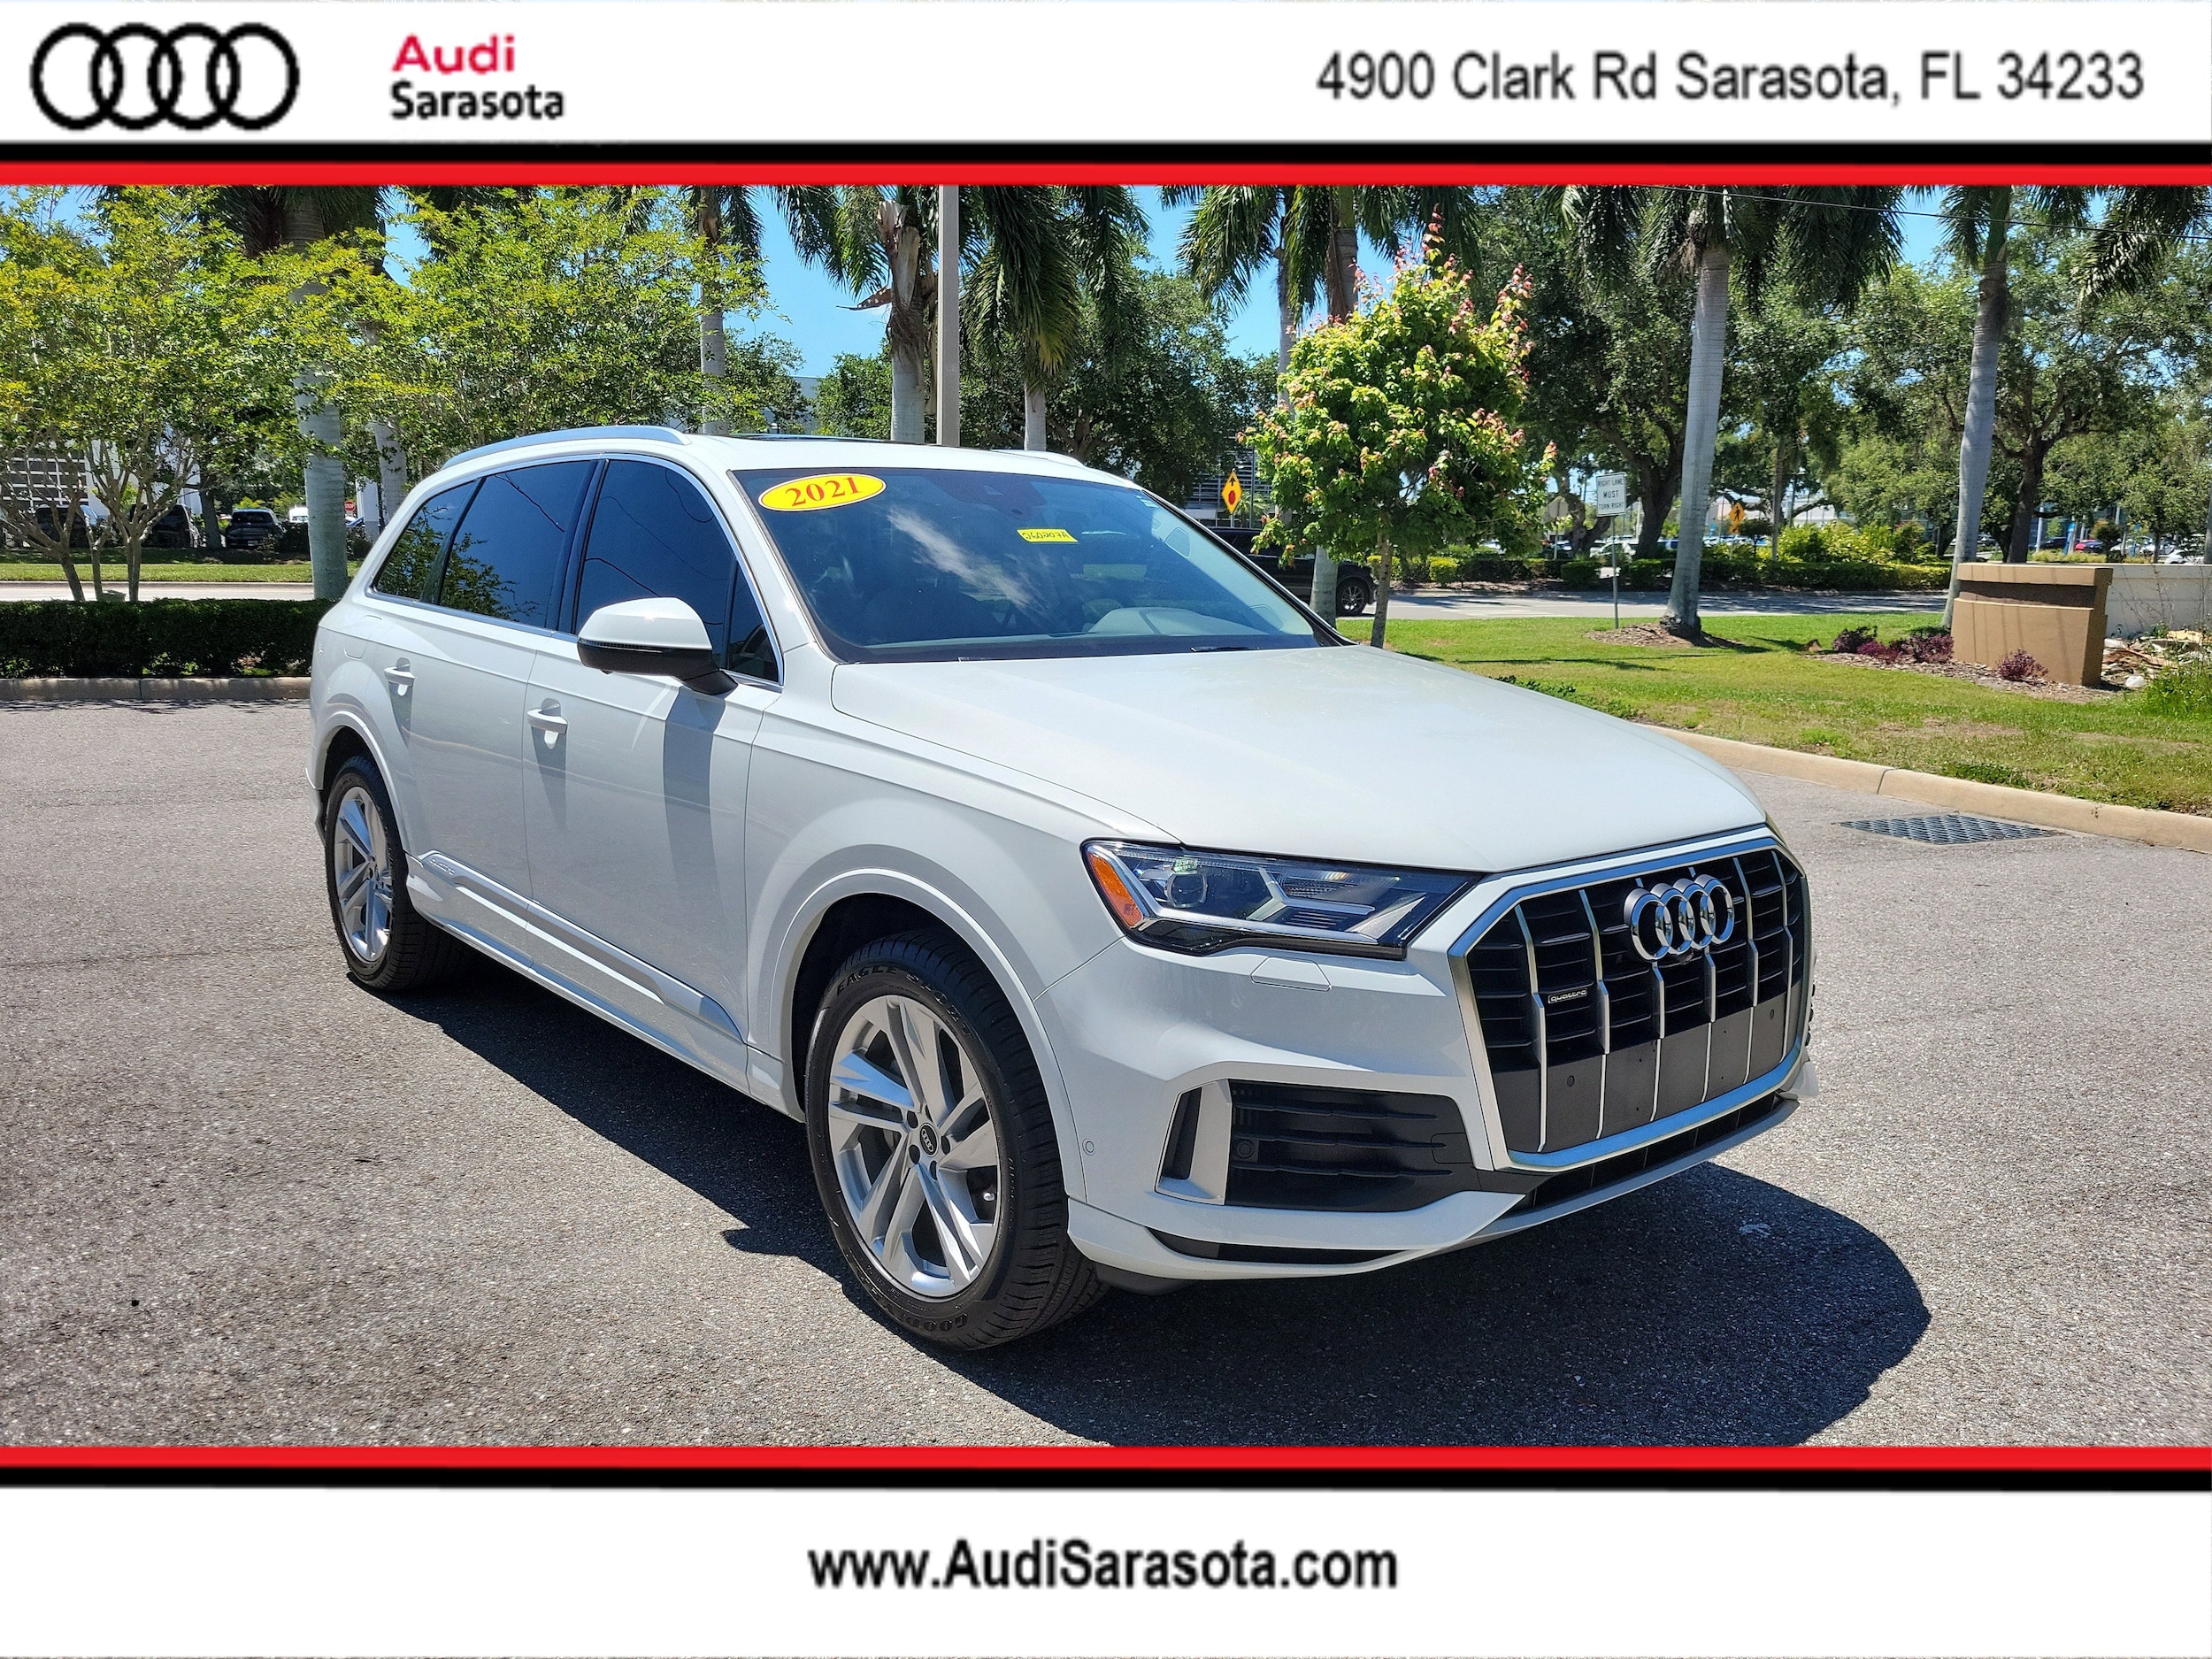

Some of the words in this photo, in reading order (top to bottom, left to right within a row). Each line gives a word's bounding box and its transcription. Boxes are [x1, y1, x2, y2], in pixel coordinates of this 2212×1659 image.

[785, 476, 864, 507] 2021
[1603, 489, 1620, 499] MUST
[836, 964, 897, 996] EAGLE
[1550, 989, 1587, 1002] quattro
